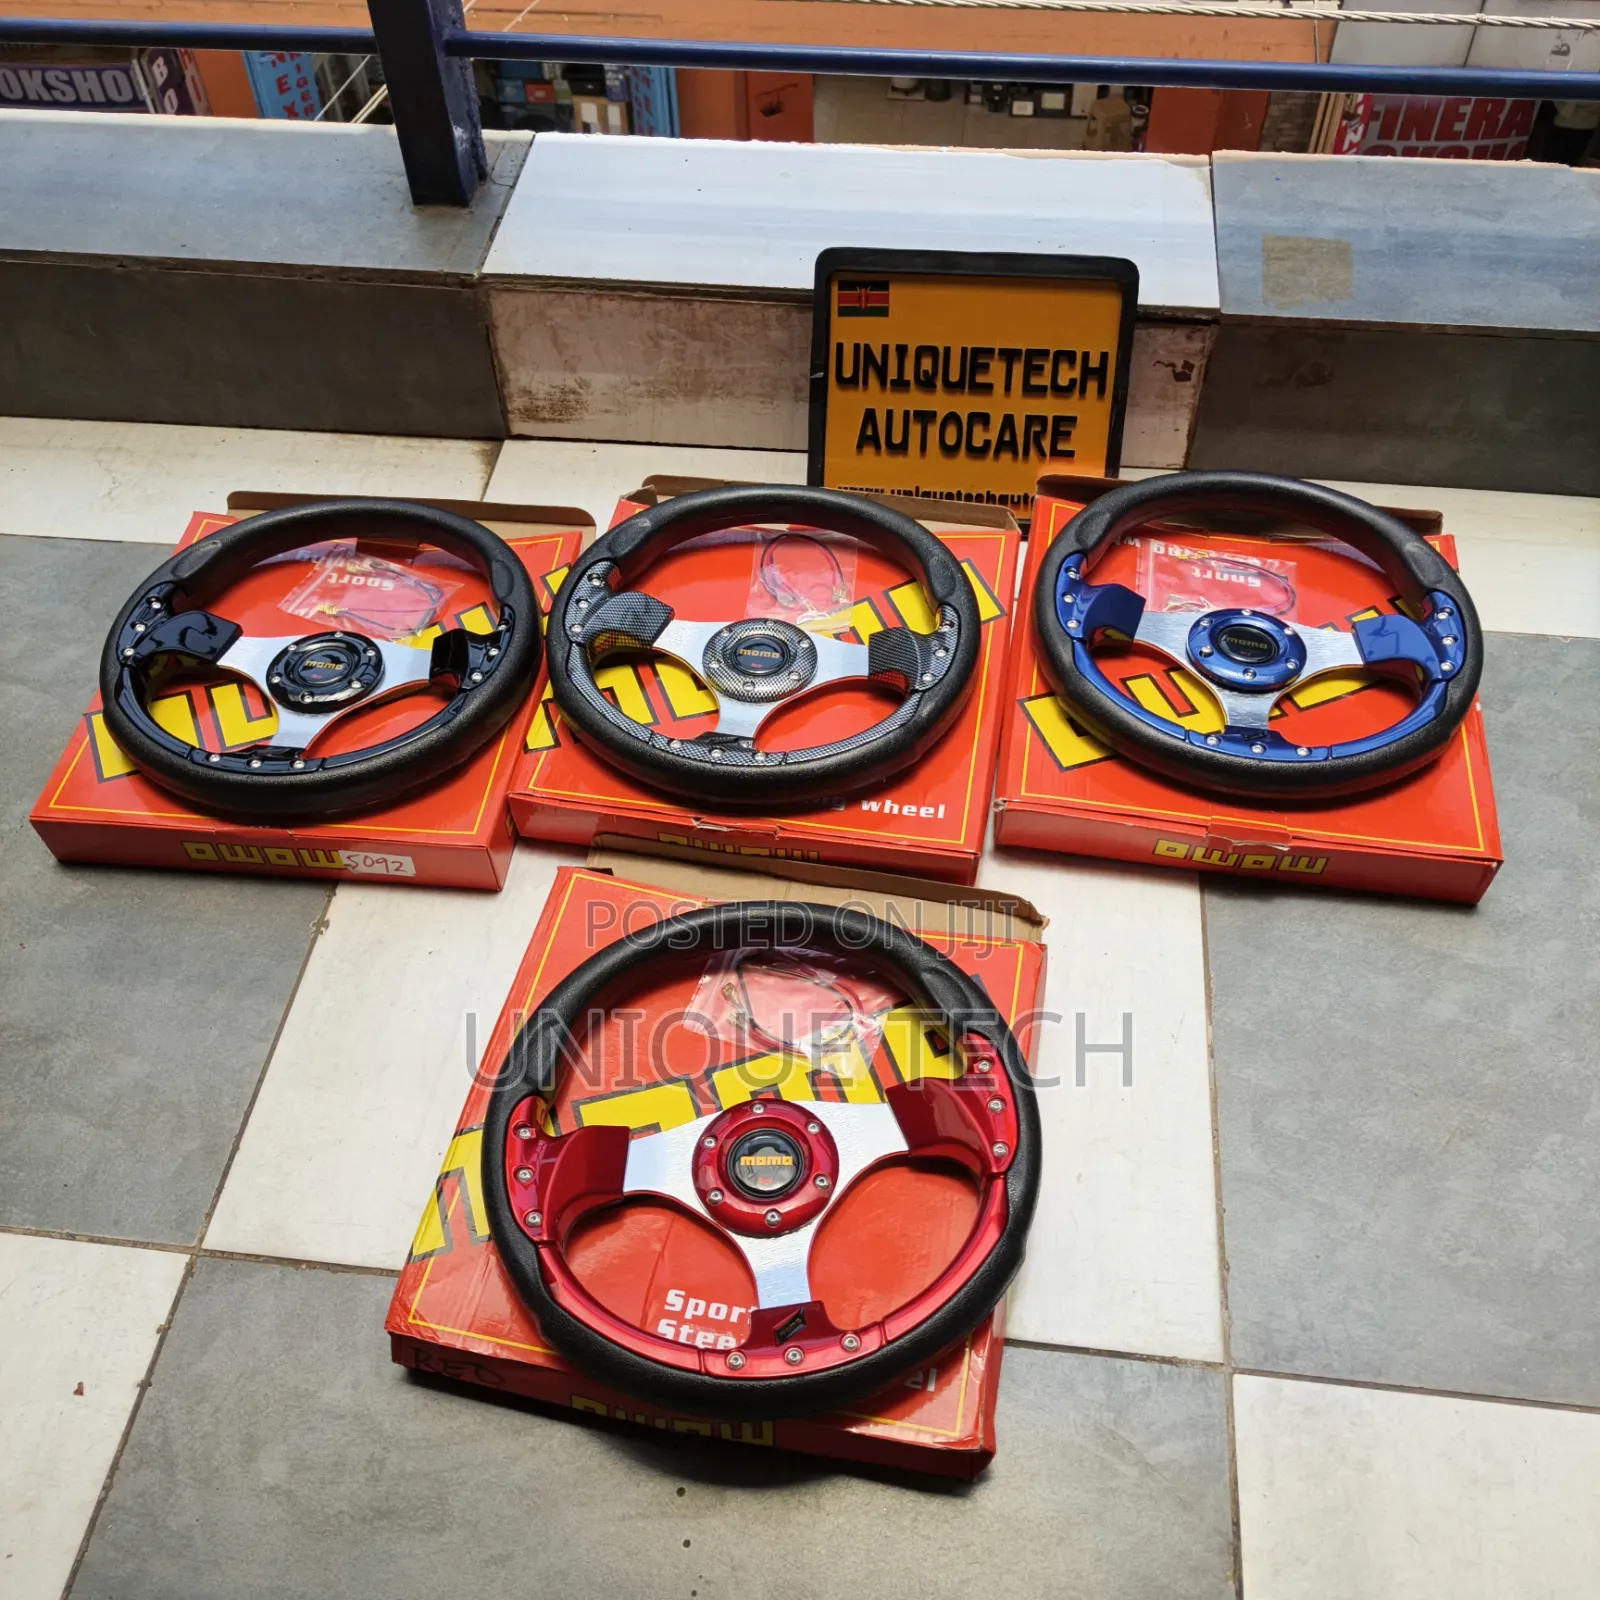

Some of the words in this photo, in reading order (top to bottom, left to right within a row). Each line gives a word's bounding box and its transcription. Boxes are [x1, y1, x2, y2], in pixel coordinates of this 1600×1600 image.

[834, 341, 1110, 398] UNIQUETECH
[855, 407, 1078, 459] AUTOCARE
[739, 648, 780, 659] momo
[861, 799, 946, 819] wheel
[740, 1155, 793, 1166] momo
